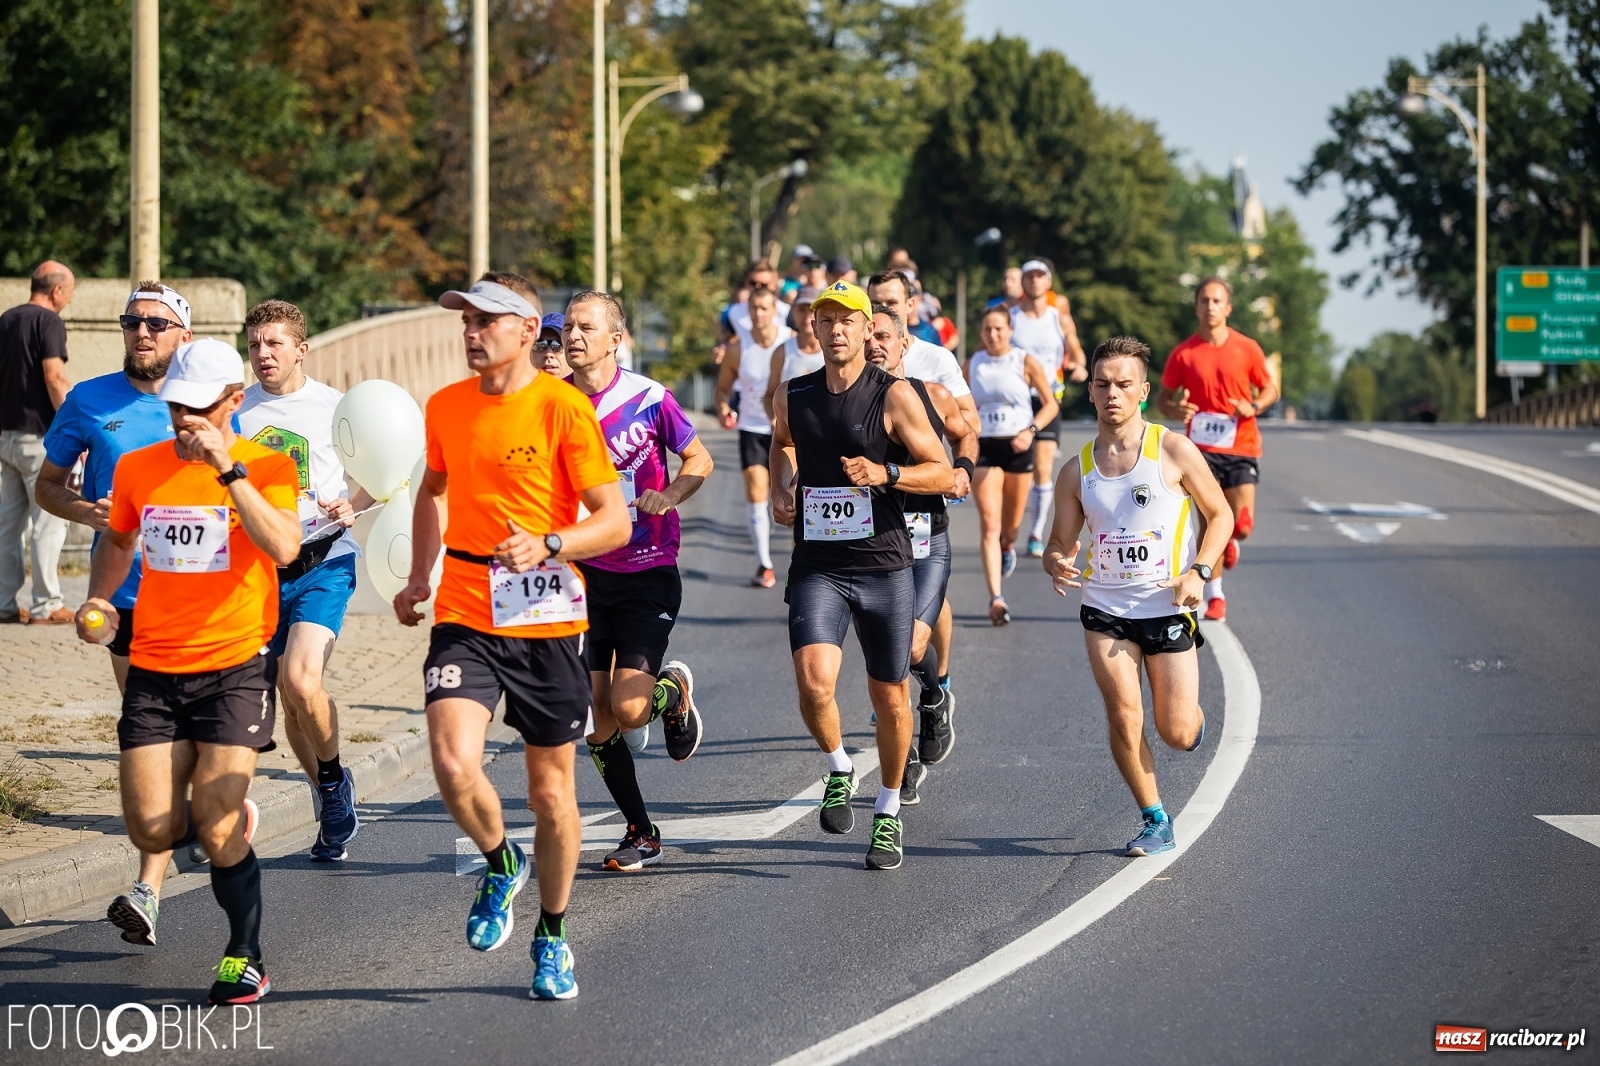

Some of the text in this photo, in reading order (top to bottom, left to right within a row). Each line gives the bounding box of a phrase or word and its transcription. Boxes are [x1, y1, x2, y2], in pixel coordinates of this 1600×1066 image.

[102, 420, 125, 432] 4F
[821, 501, 855, 519] 290
[164, 524, 205, 546] 407
[1117, 545, 1149, 564] 140
[521, 574, 562, 598] 194
[425, 664, 462, 693] 88
